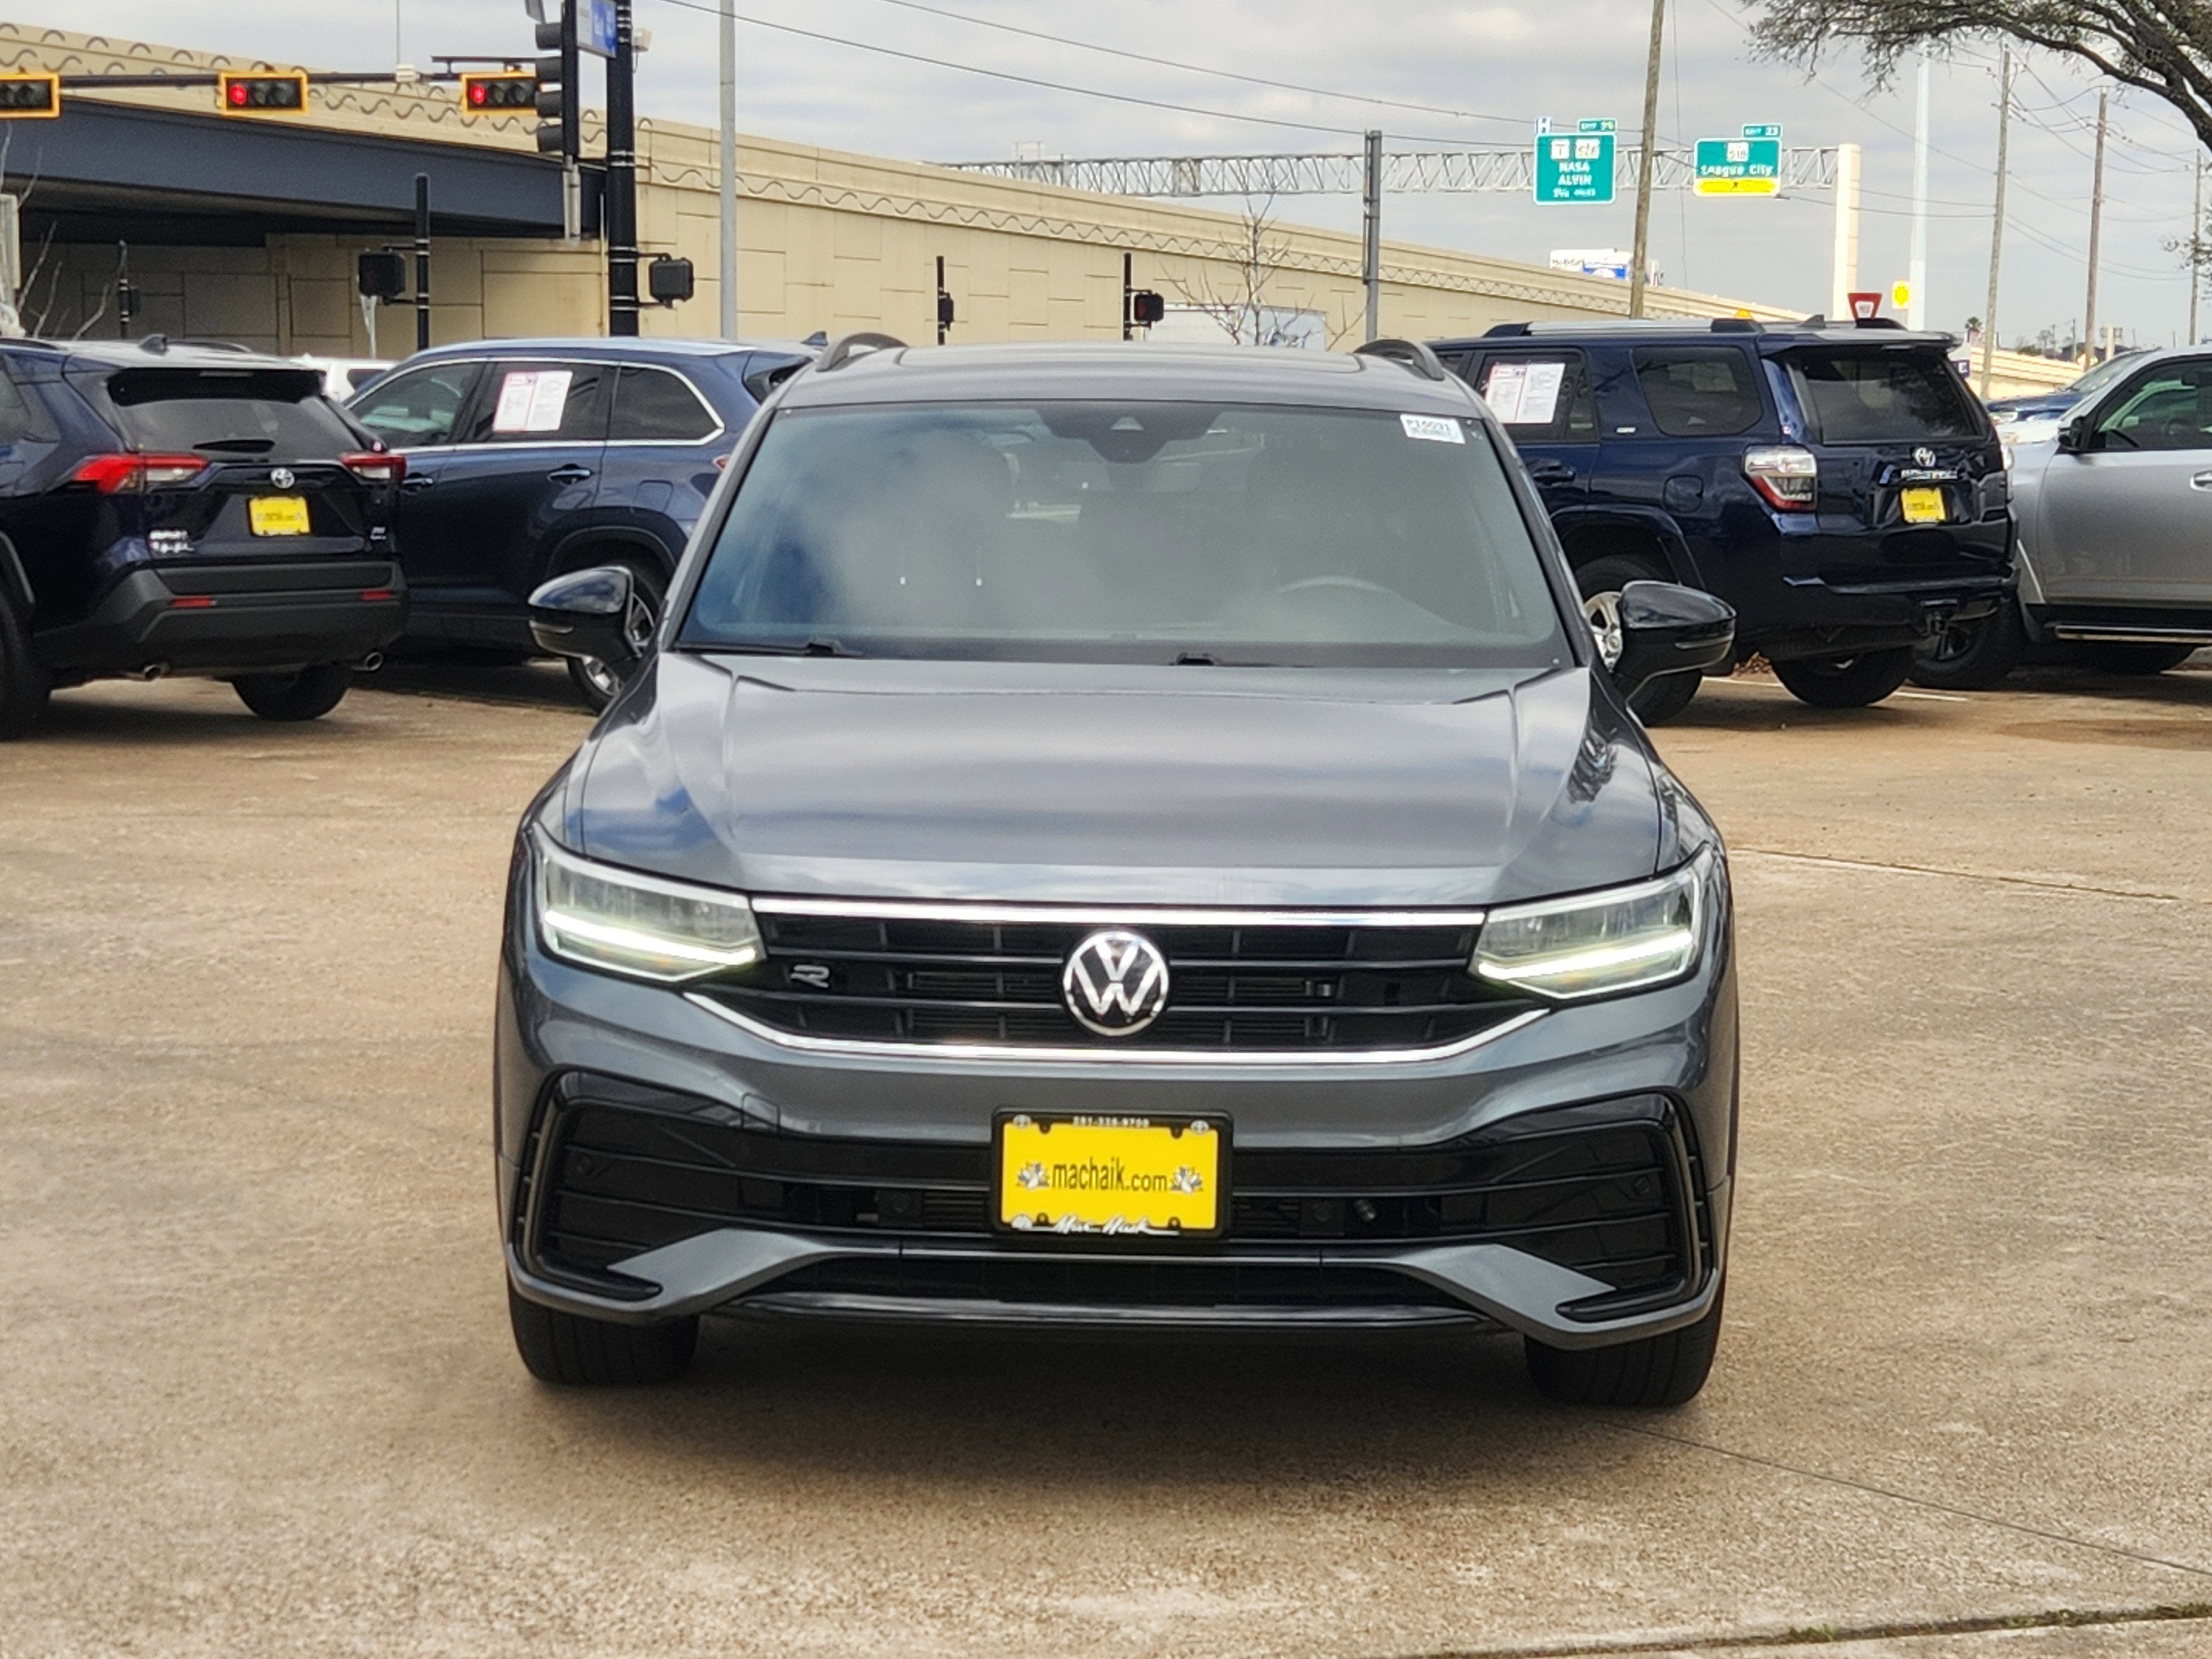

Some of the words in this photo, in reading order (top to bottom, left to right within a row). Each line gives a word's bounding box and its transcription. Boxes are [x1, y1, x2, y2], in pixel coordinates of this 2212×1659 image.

[1558, 161, 1590, 173] NASA
[1749, 164, 1774, 177] City
[1558, 174, 1593, 186] ALVIN
[1051, 1156, 1168, 1192] machaik.com
